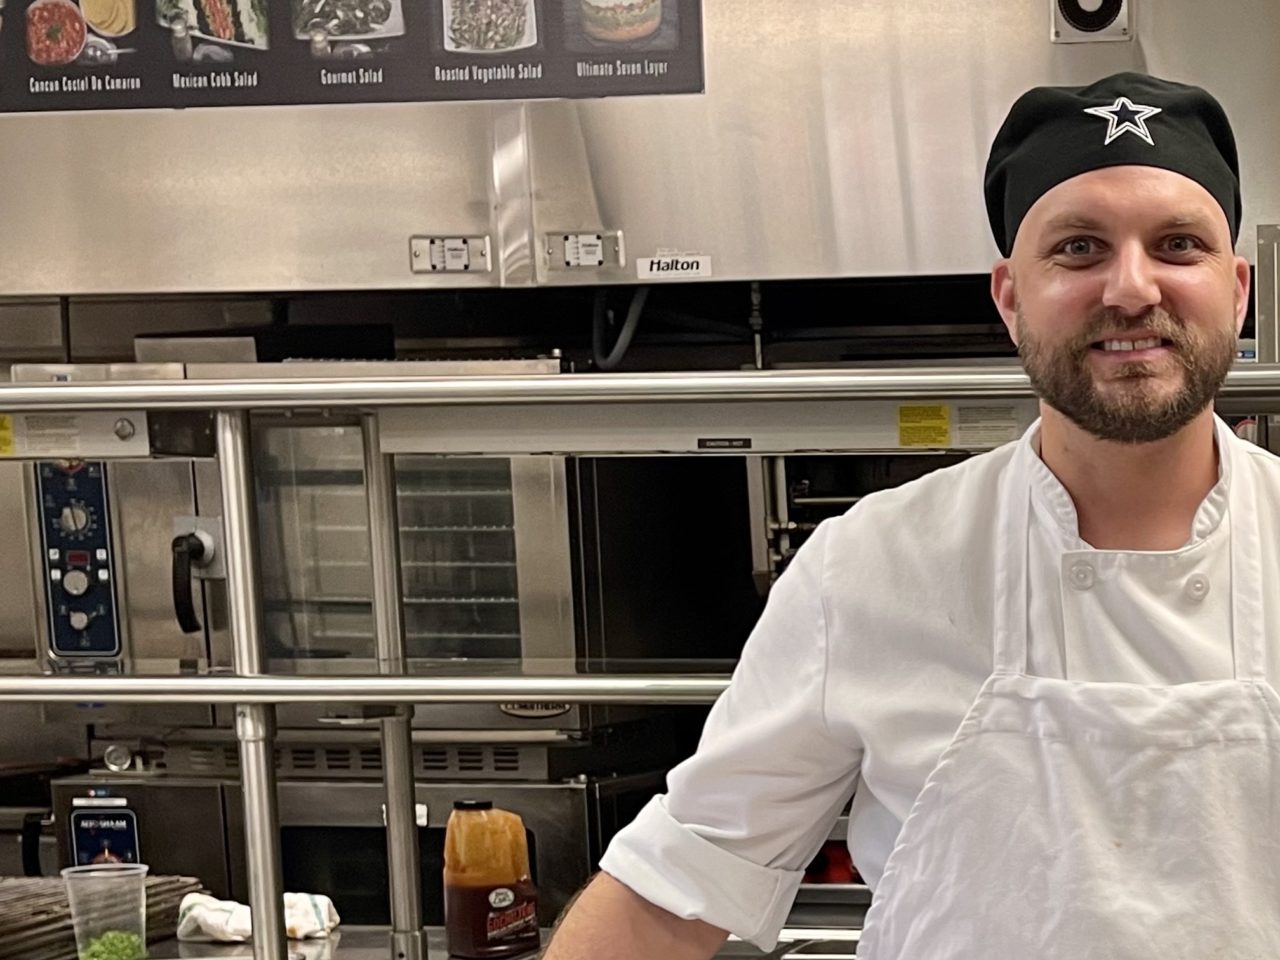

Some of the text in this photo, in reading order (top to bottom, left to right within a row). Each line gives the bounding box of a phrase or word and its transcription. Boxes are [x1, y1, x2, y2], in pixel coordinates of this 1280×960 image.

[320, 67, 383, 85] Gourmet Salad
[434, 63, 542, 84] Roasted Vegetable Salad
[577, 59, 668, 77] Ultimate Seven Layer
[29, 77, 60, 93] Cancun
[172, 71, 258, 88] Mexican Cobb Salad
[650, 259, 700, 272] Halton
